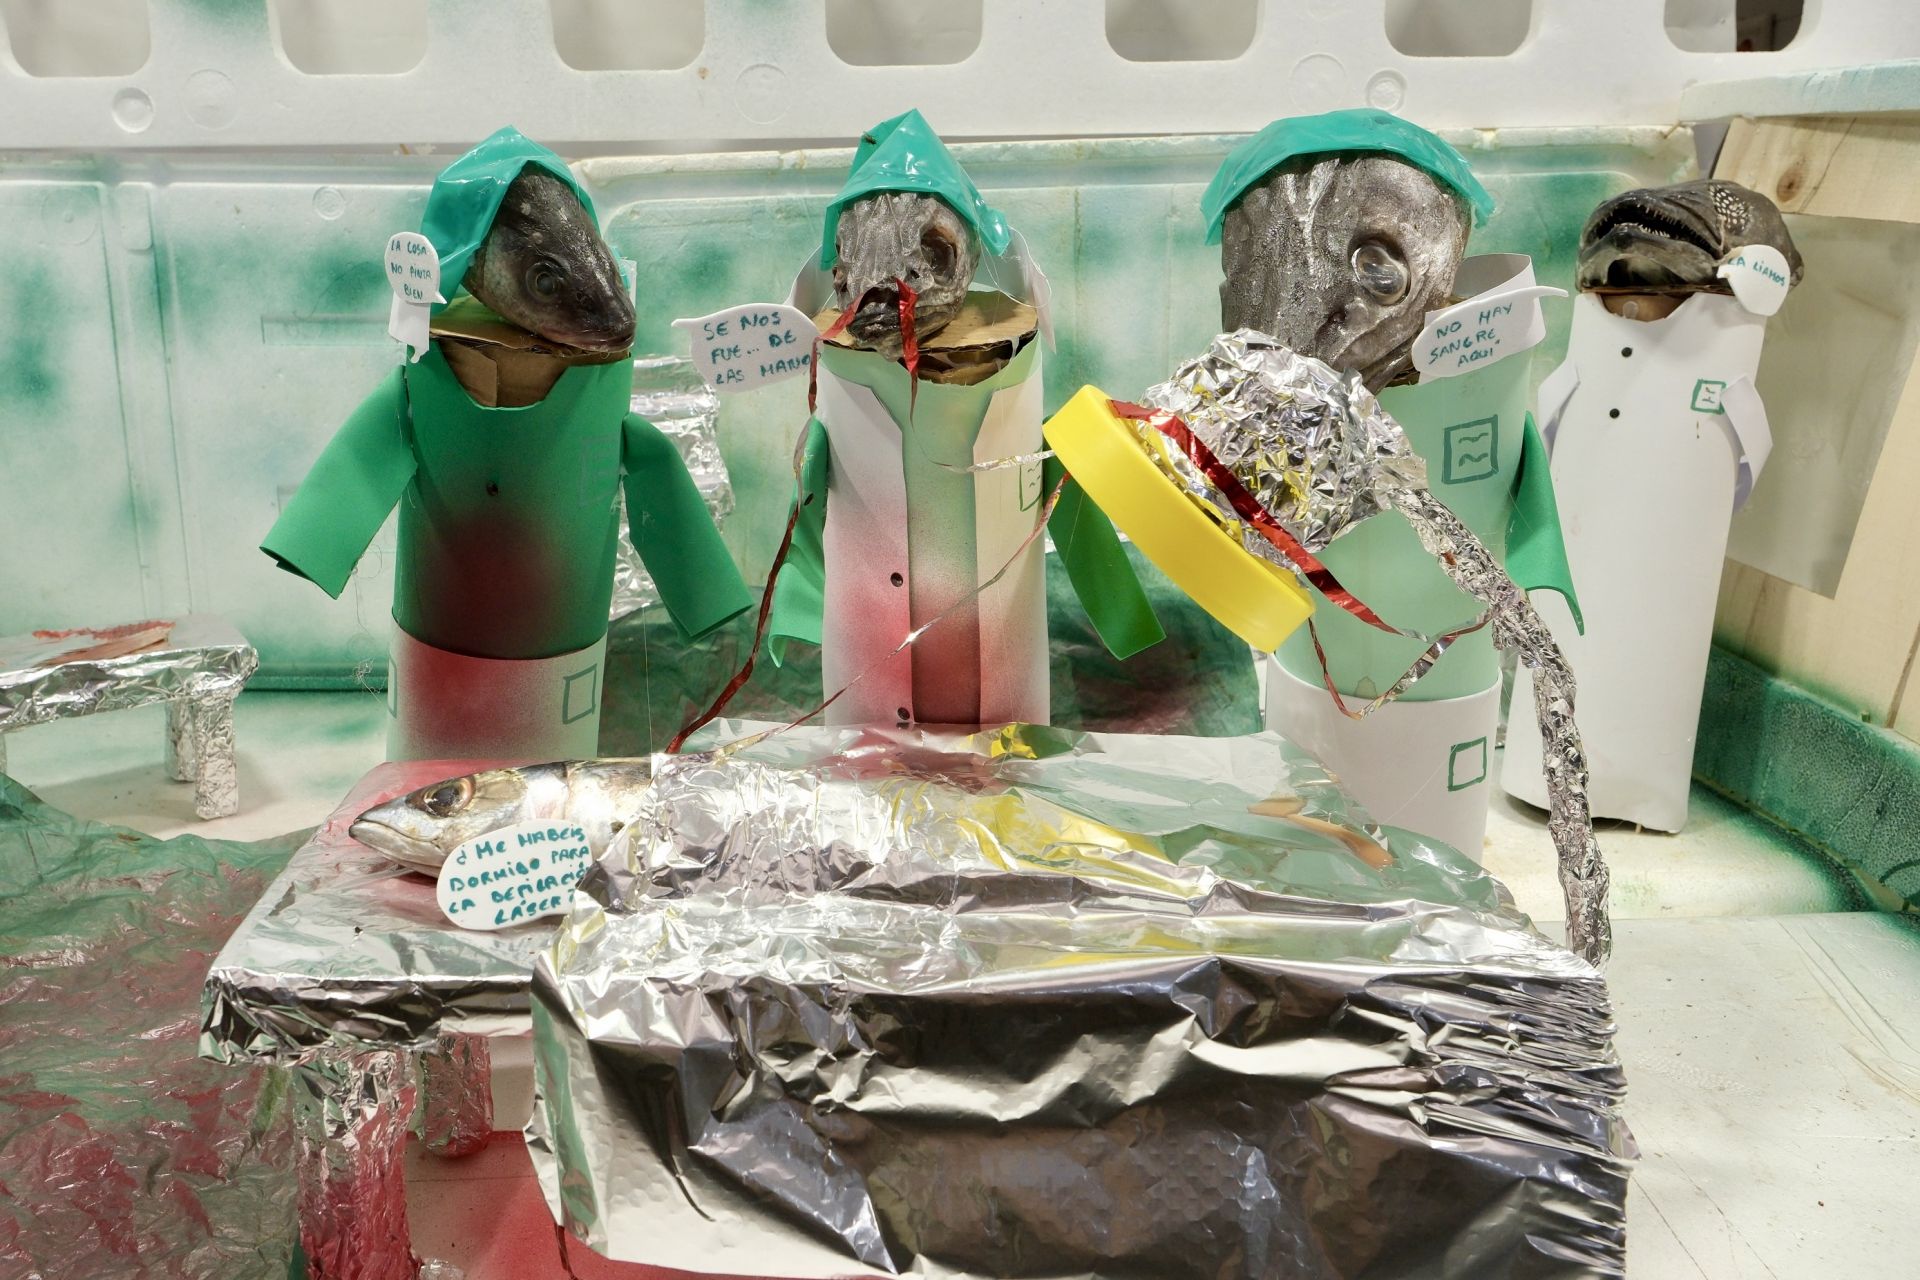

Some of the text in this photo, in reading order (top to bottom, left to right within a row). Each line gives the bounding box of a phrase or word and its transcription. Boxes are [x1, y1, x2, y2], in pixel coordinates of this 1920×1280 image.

[391, 240, 427, 255] LA COSA
[391, 263, 432, 279] NO PINTA
[404, 284, 423, 300] BIEN
[704, 312, 781, 340] SE NOS
[1437, 302, 1512, 339] NO HAY
[769, 330, 796, 347] DE
[1429, 328, 1496, 364] SANGRE
[716, 348, 821, 384] LAS MANO
[450, 845, 589, 892] DORMIDO PARA
[449, 861, 589, 914] LA DEPILACIÓ
